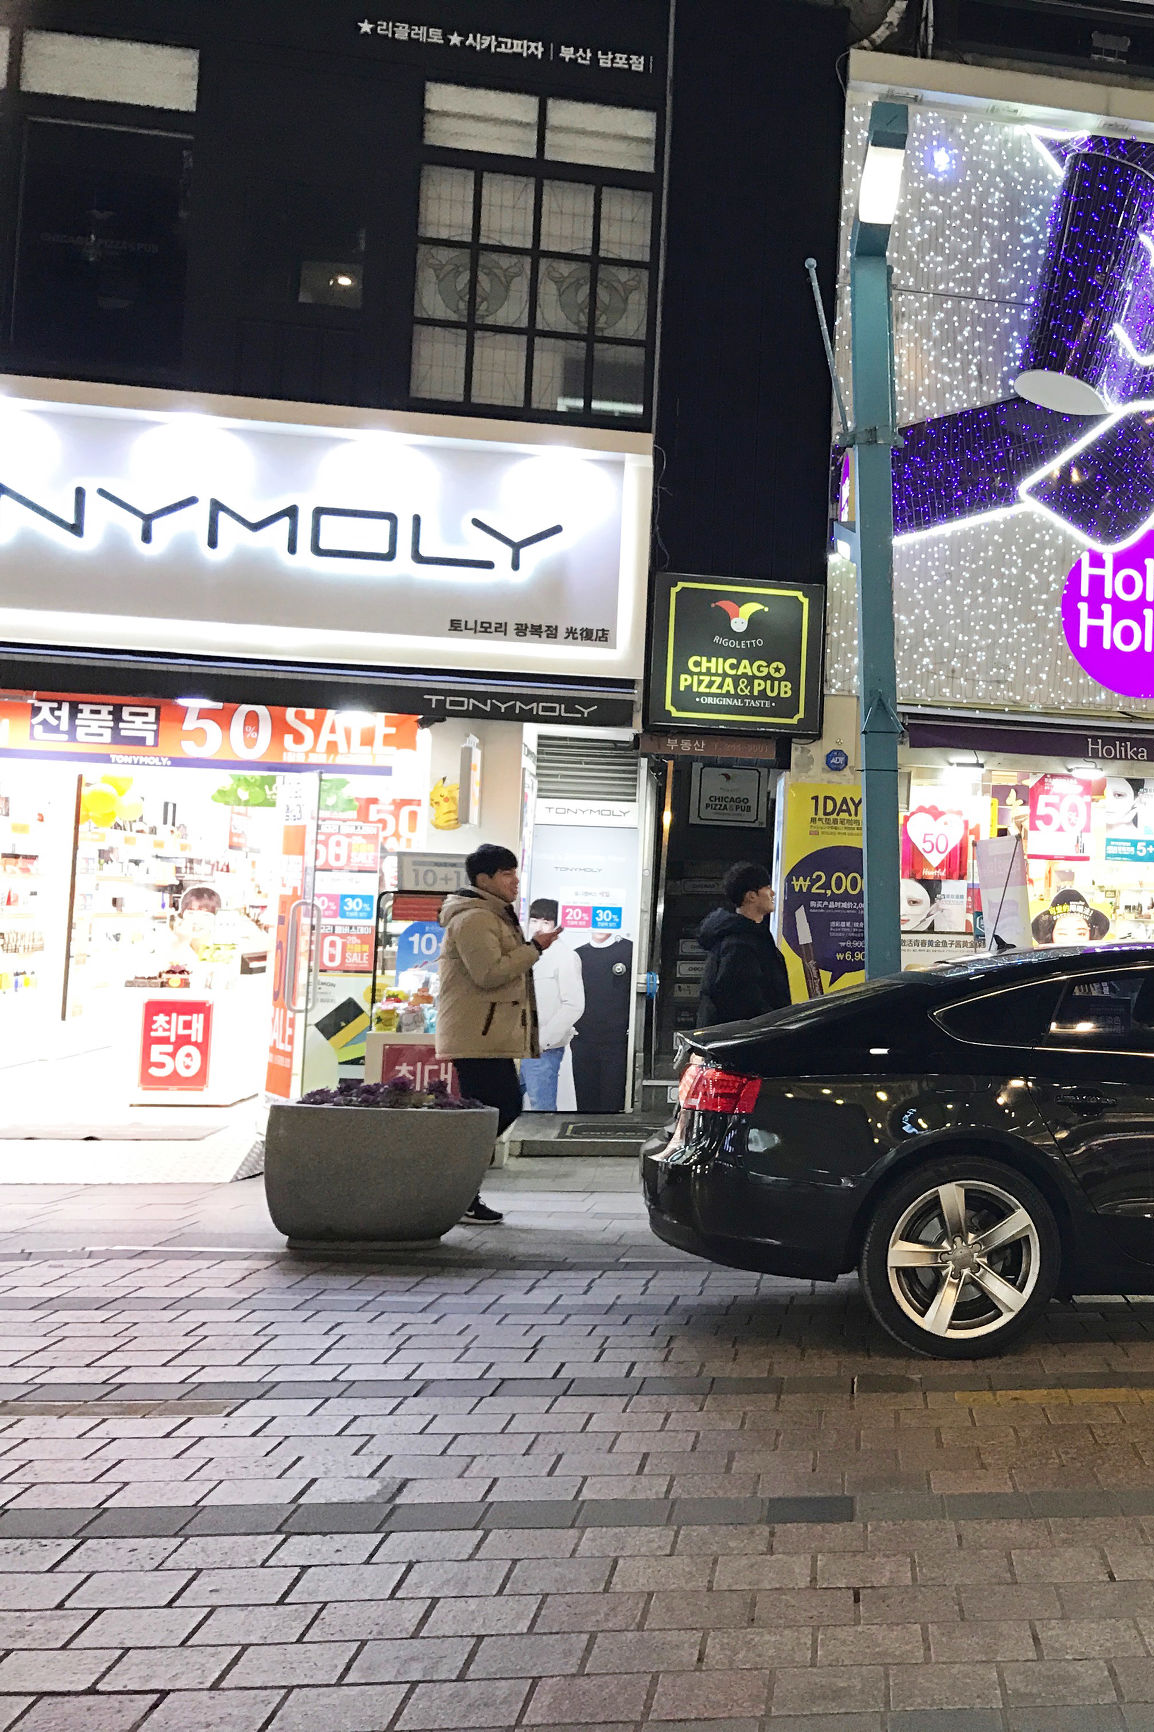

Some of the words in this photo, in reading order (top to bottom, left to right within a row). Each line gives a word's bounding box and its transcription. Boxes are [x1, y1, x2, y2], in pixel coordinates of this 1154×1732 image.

[376, 20, 444, 44] 리골레토
[465, 32, 545, 59] 시카고피자
[559, 45, 592, 65] 부산
[598, 50, 645, 72] 남포점
[448, 617, 509, 637] 토니모리
[514, 621, 560, 641] 광복점
[564, 626, 611, 644] 光復店
[713, 635, 764, 649] RIGOLETTO
[688, 656, 787, 678] CHICAGO
[424, 694, 598, 719] TONYMOLY
[701, 696, 743, 707] ORIGINAL
[744, 699, 771, 708] TASTE
[31, 701, 158, 747] 전품목
[283, 706, 398, 754] SALE
[667, 739, 706, 752] 부동산
[1087, 738, 1149, 761] Holika
[830, 756, 845, 765] ADT
[708, 795, 750, 804] CHICAGO
[544, 806, 631, 818] TONYMOLY
[922, 833, 949, 855] 50
[791, 871, 865, 898] ₩2,00
[345, 952, 369, 964] SALE
[151, 1013, 204, 1043] 최대
